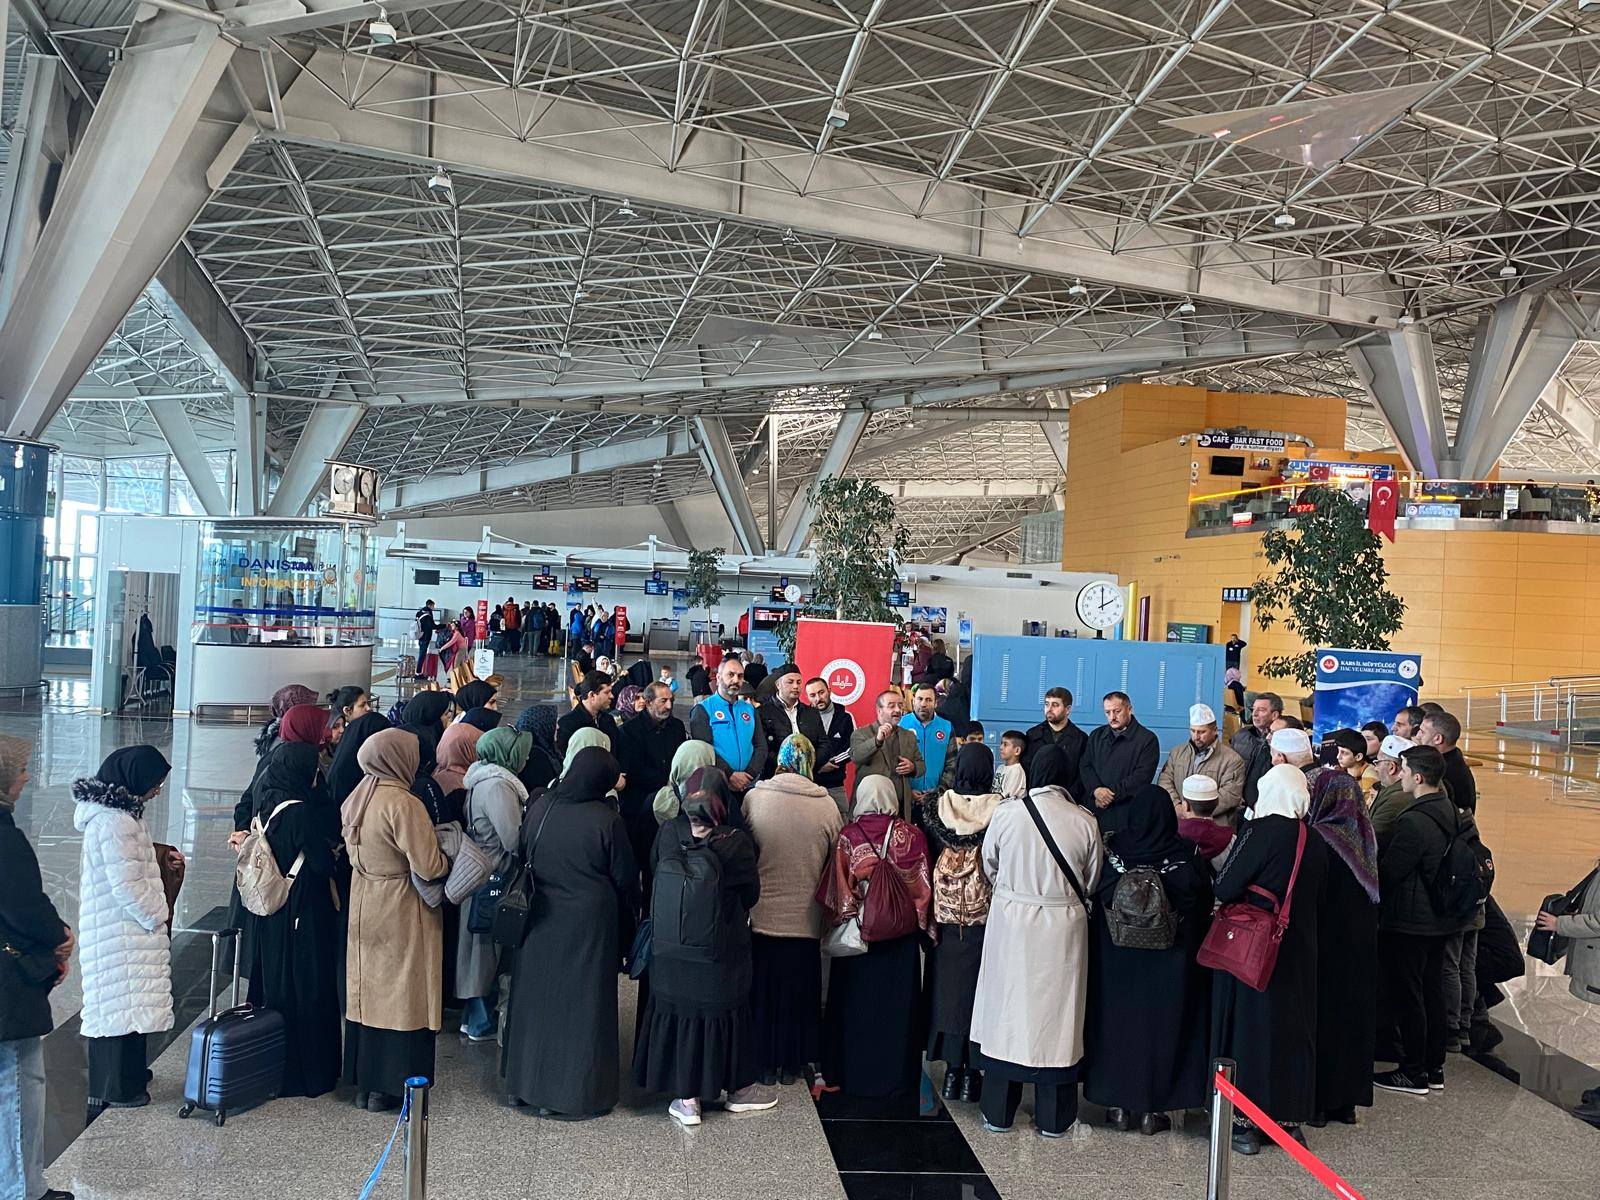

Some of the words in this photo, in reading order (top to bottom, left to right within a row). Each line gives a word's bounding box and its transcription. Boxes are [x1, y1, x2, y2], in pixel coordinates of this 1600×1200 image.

[1212, 435, 1229, 444] CAFE
[1234, 436, 1247, 444] BAR
[1248, 437, 1264, 445] FAST
[1265, 438, 1284, 446] FOOD
